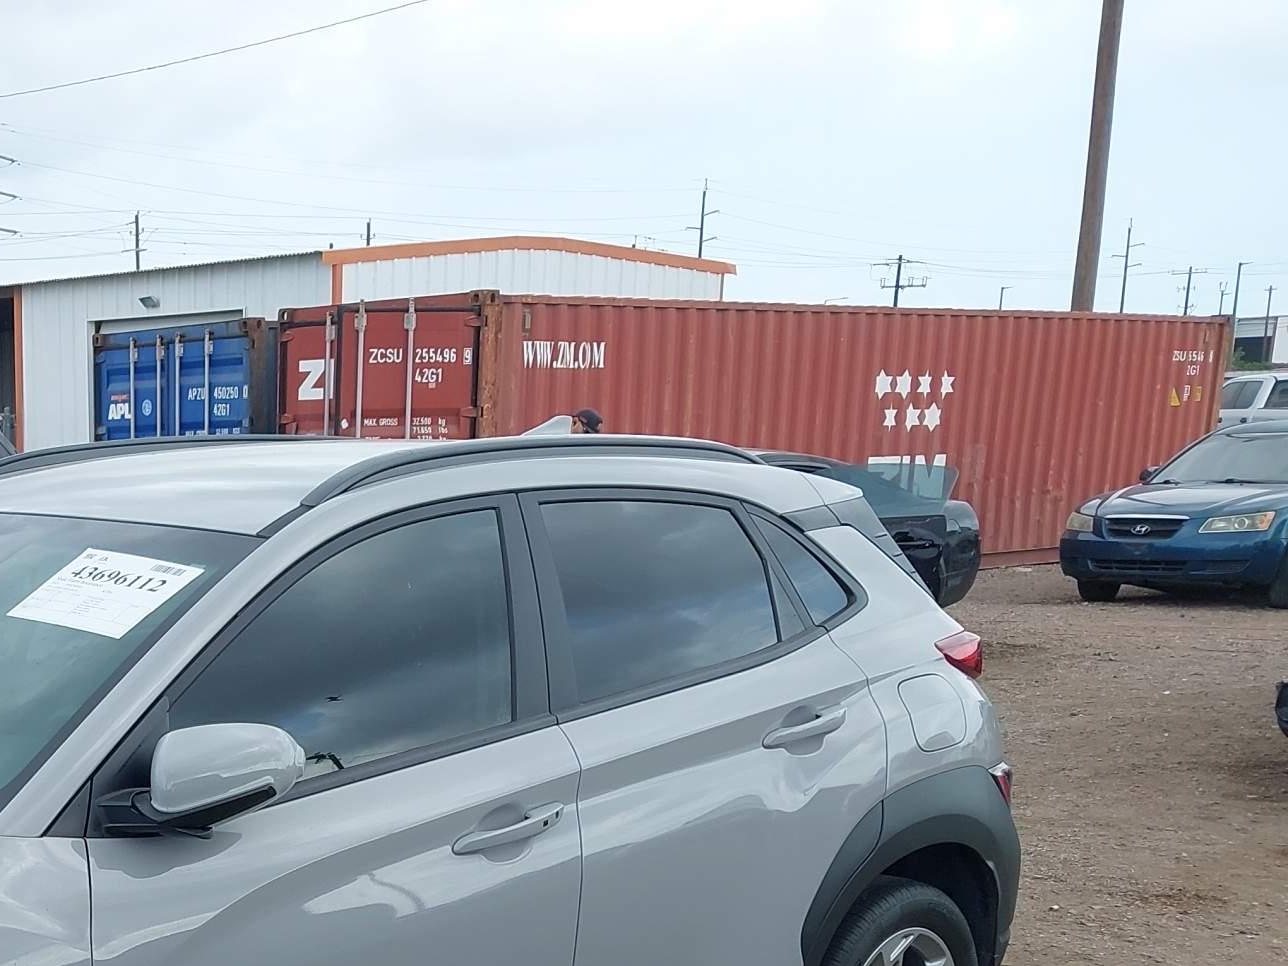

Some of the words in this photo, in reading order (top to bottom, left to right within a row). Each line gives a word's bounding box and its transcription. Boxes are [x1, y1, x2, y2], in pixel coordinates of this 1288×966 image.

[368, 347, 403, 364] ZCSU
[414, 348, 457, 363] 255496
[464, 348, 472, 364] 9
[414, 367, 442, 383] 42G1
[187, 387, 207, 401] APZU
[213, 386, 239, 400] 450250
[107, 402, 132, 421] APL
[213, 403, 230, 417] 42G1
[379, 417, 399, 427] GROSS
[71, 565, 167, 592] 43696112
